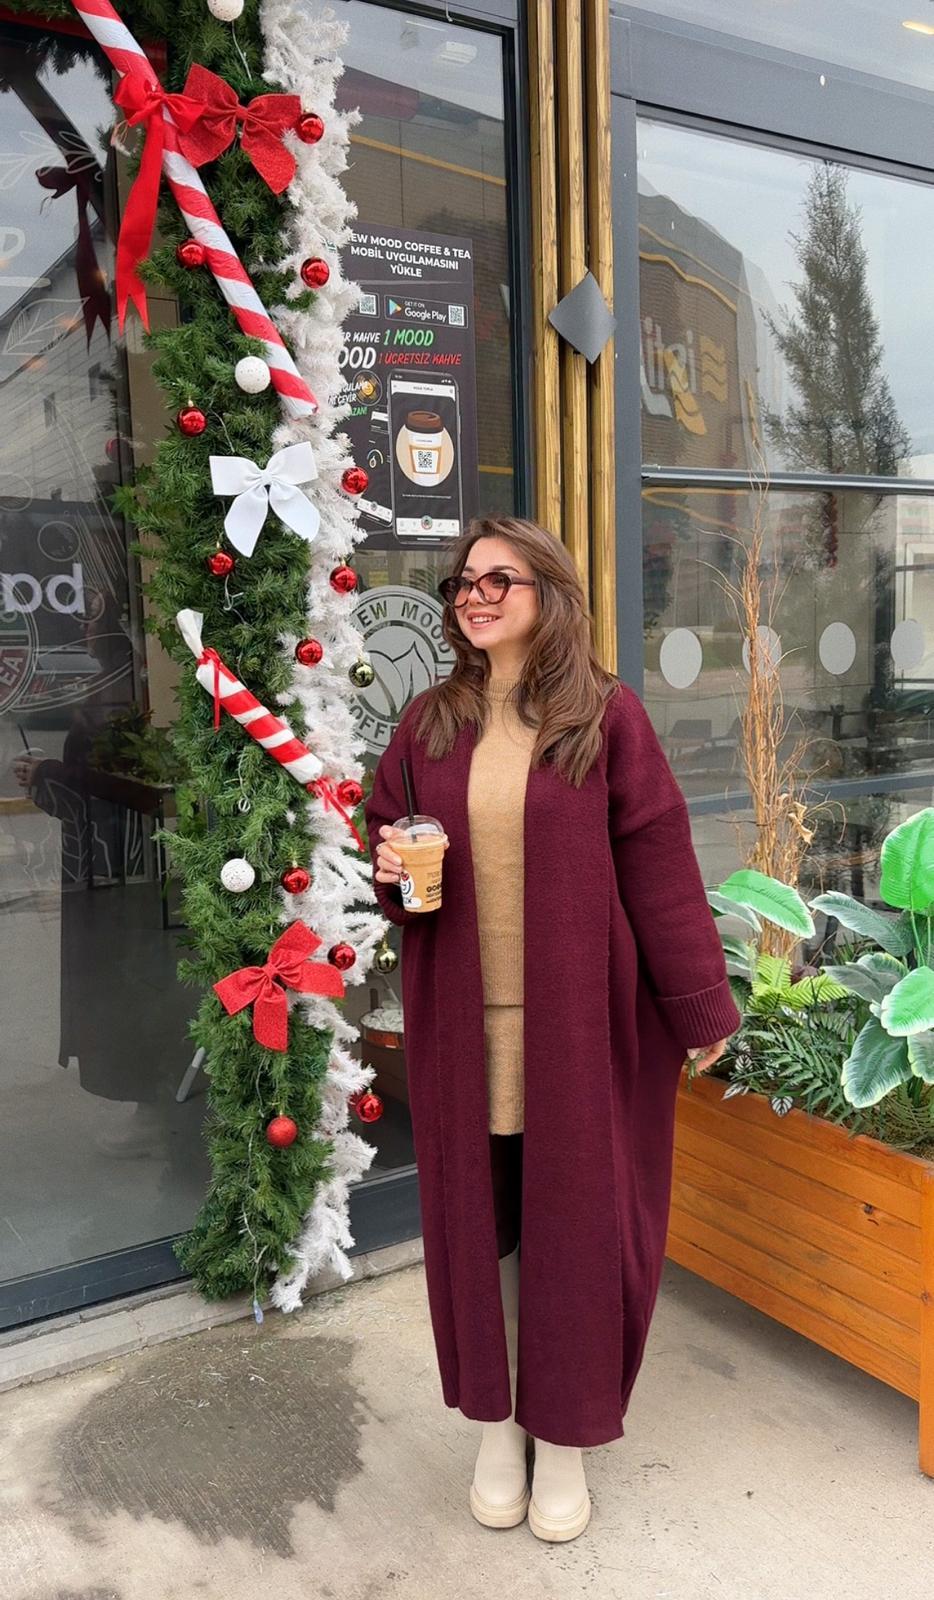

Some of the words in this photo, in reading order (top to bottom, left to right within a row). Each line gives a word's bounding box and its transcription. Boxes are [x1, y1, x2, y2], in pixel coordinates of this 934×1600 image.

[350, 245, 384, 260] MOBİL
[386, 252, 459, 270] UYGULAMASINI
[351, 233, 368, 244] EW
[370, 237, 402, 249] MOOD
[404, 241, 442, 255] COFFEE
[443, 248, 451, 256] &
[452, 248, 471, 260] TEA
[390, 263, 423, 278] YÜKLE
[404, 307, 431, 321] Google
[431, 310, 447, 323] Play
[353, 331, 381, 343] KAHVE
[383, 329, 392, 346] 1
[393, 329, 434, 346] MOOD
[337, 346, 377, 369] OOD
[432, 353, 462, 365] KAHVE
[356, 600, 388, 628] EW
[0, 656, 24, 688] EA
